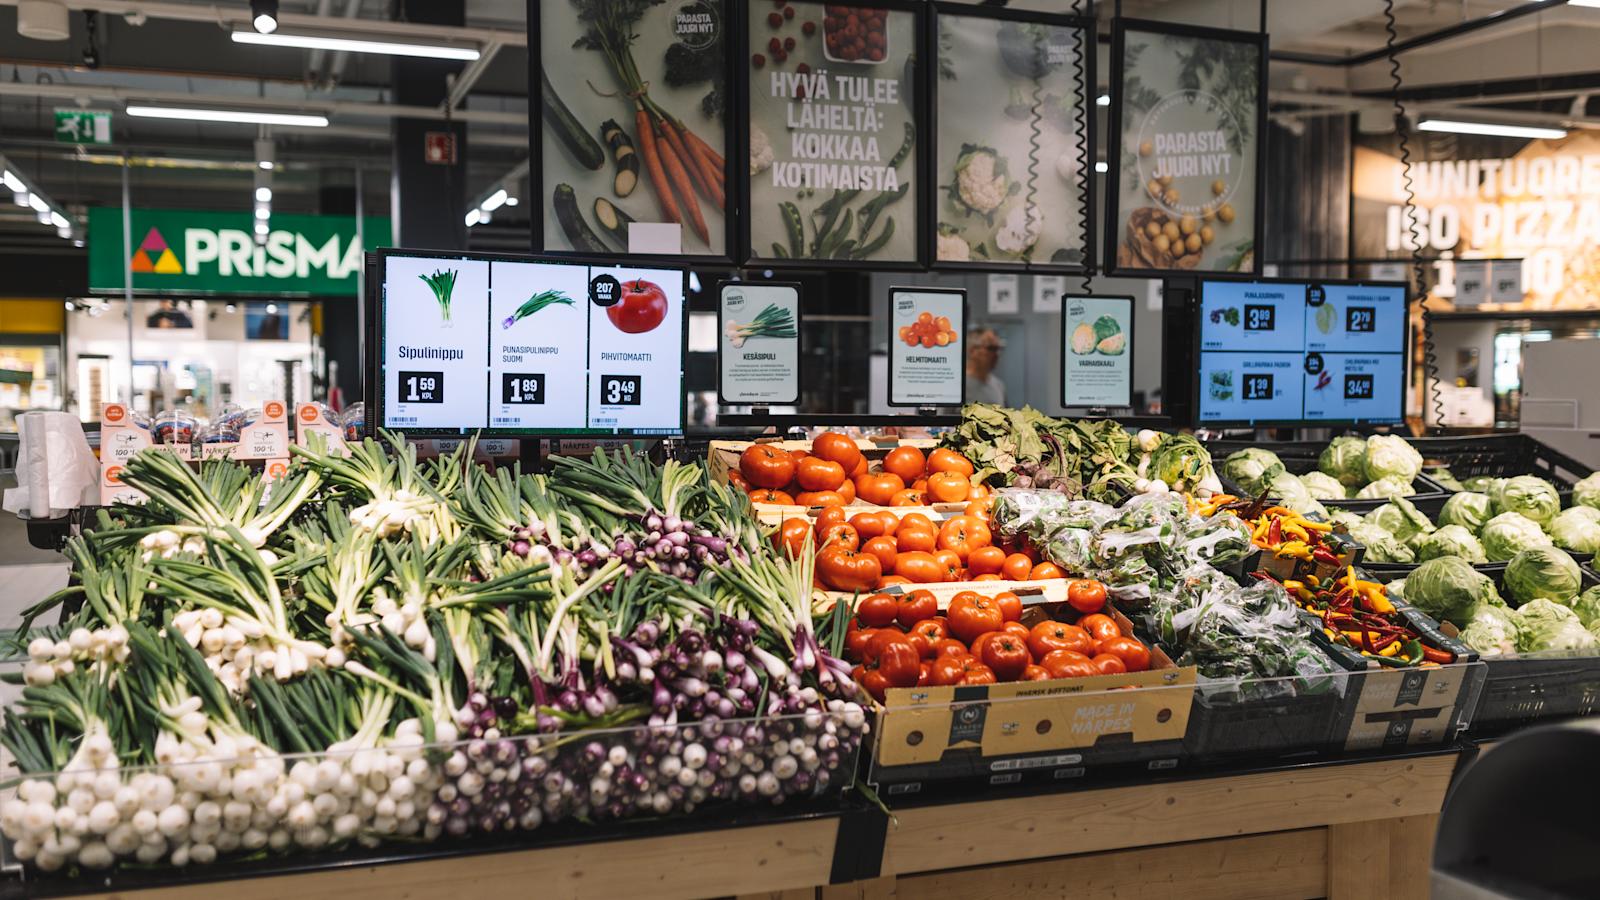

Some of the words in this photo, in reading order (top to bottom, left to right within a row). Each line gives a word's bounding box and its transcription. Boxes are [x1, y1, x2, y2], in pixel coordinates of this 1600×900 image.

[676, 14, 711, 23] PARASTA
[676, 24, 698, 33] JUURI
[700, 24, 713, 33] NYT
[771, 69, 830, 99] HYVÄ
[835, 76, 898, 104] TULEE
[787, 98, 883, 132] LÄHELTÄ:
[792, 133, 880, 161] KOKKAA
[1155, 130, 1227, 154] PARASTA
[1152, 155, 1199, 178] JUURI
[1201, 154, 1231, 175] NYT
[772, 162, 899, 192] KOTIMAISTA
[1386, 204, 1460, 251] ISO
[1471, 200, 1600, 250] PIZZA
[596, 283, 614, 293] 207
[1249, 308, 1260, 329] 3
[1351, 311, 1361, 331] 2
[399, 346, 464, 361] Sipulinippu
[502, 346, 558, 354] PUNASIPULINIPPU
[601, 352, 652, 362] PIHVITOMAATTI
[743, 352, 776, 360] KESÄSIPULI
[906, 356, 947, 364] HELMITOMAATTI
[407, 376, 420, 400] 1
[420, 378, 435, 390] 59
[422, 392, 434, 400] KPL
[510, 378, 522, 402] 1
[522, 380, 538, 392] 89
[608, 380, 621, 404] 3
[621, 381, 635, 393] 49
[1248, 378, 1257, 398] 1
[1348, 380, 1362, 394] 34
[562, 441, 590, 449] NÄRPES
[1073, 704, 1116, 720] MADE
[1117, 702, 1137, 715] IN
[1071, 716, 1134, 736] NÄRPES
